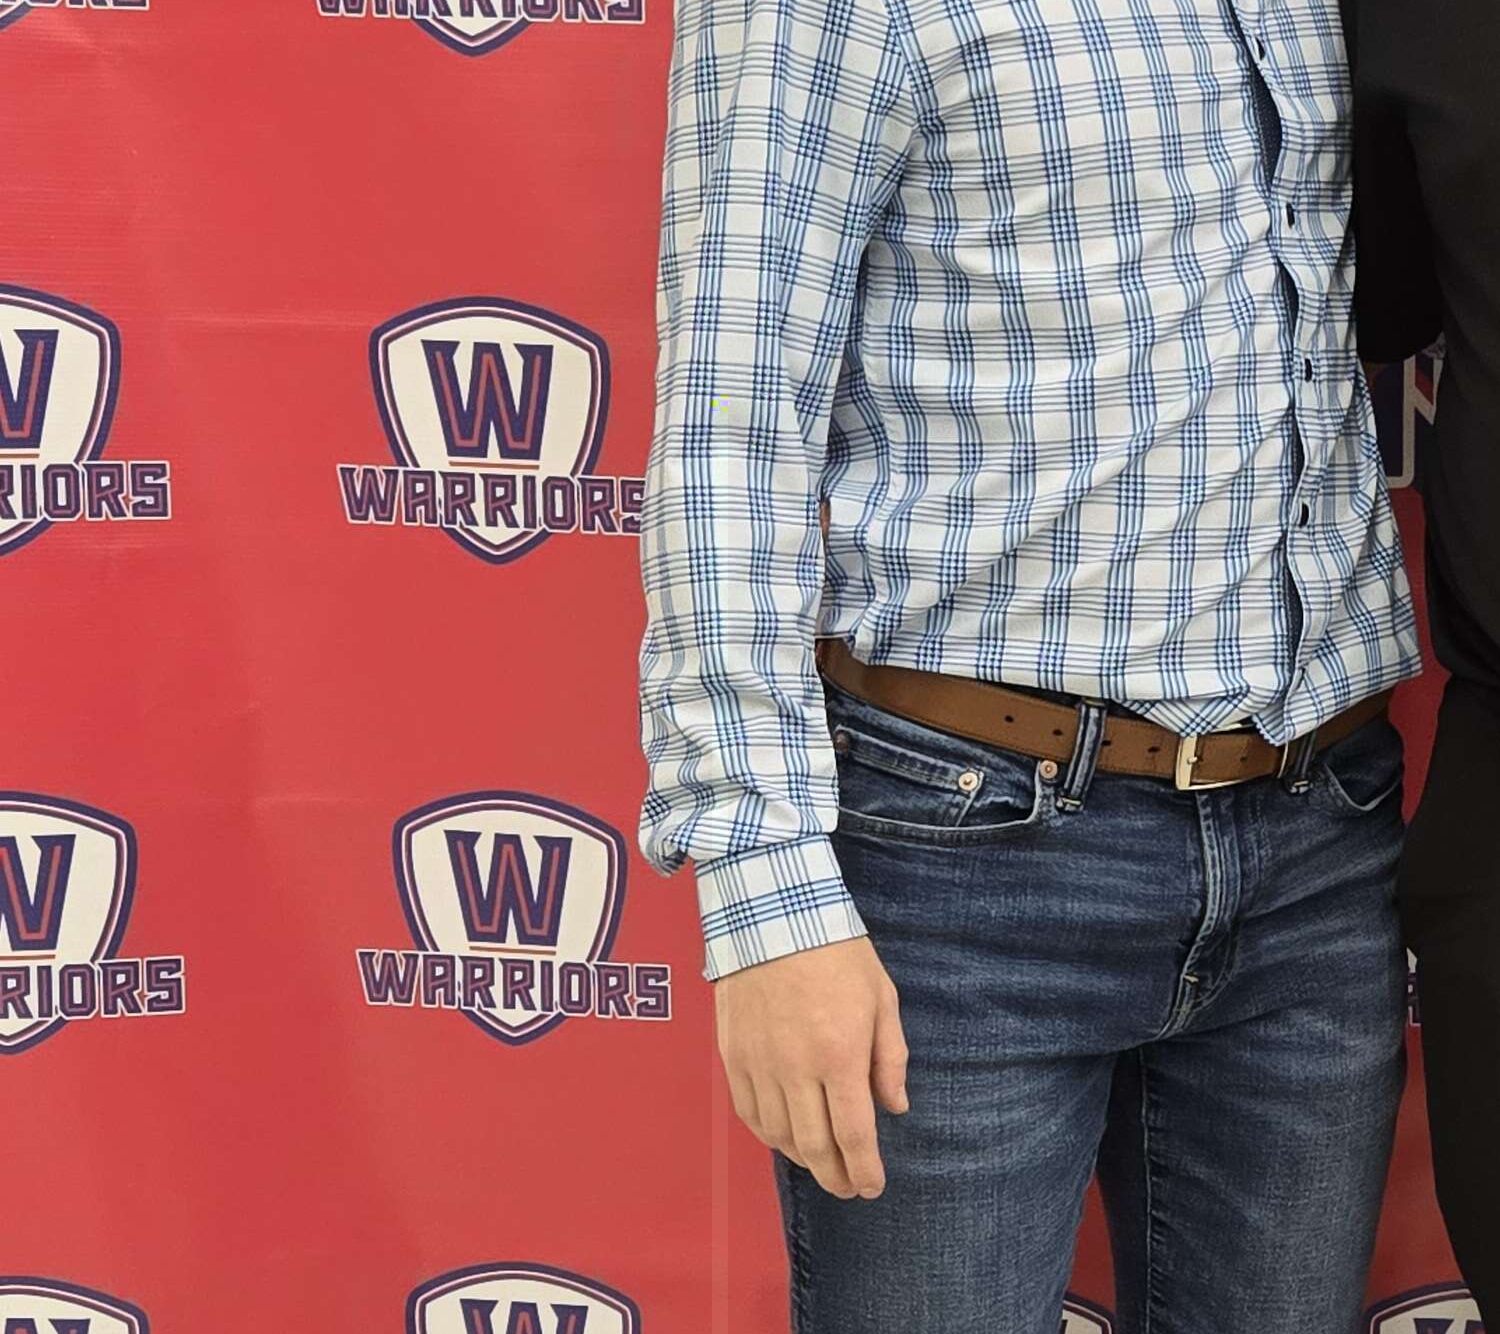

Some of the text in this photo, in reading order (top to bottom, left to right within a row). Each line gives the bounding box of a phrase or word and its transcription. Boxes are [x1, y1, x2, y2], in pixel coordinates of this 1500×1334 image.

[420, 339, 553, 460] W
[337, 464, 645, 535] WARRIORS
[444, 830, 572, 952] W
[356, 949, 672, 1021] WARRIORS
